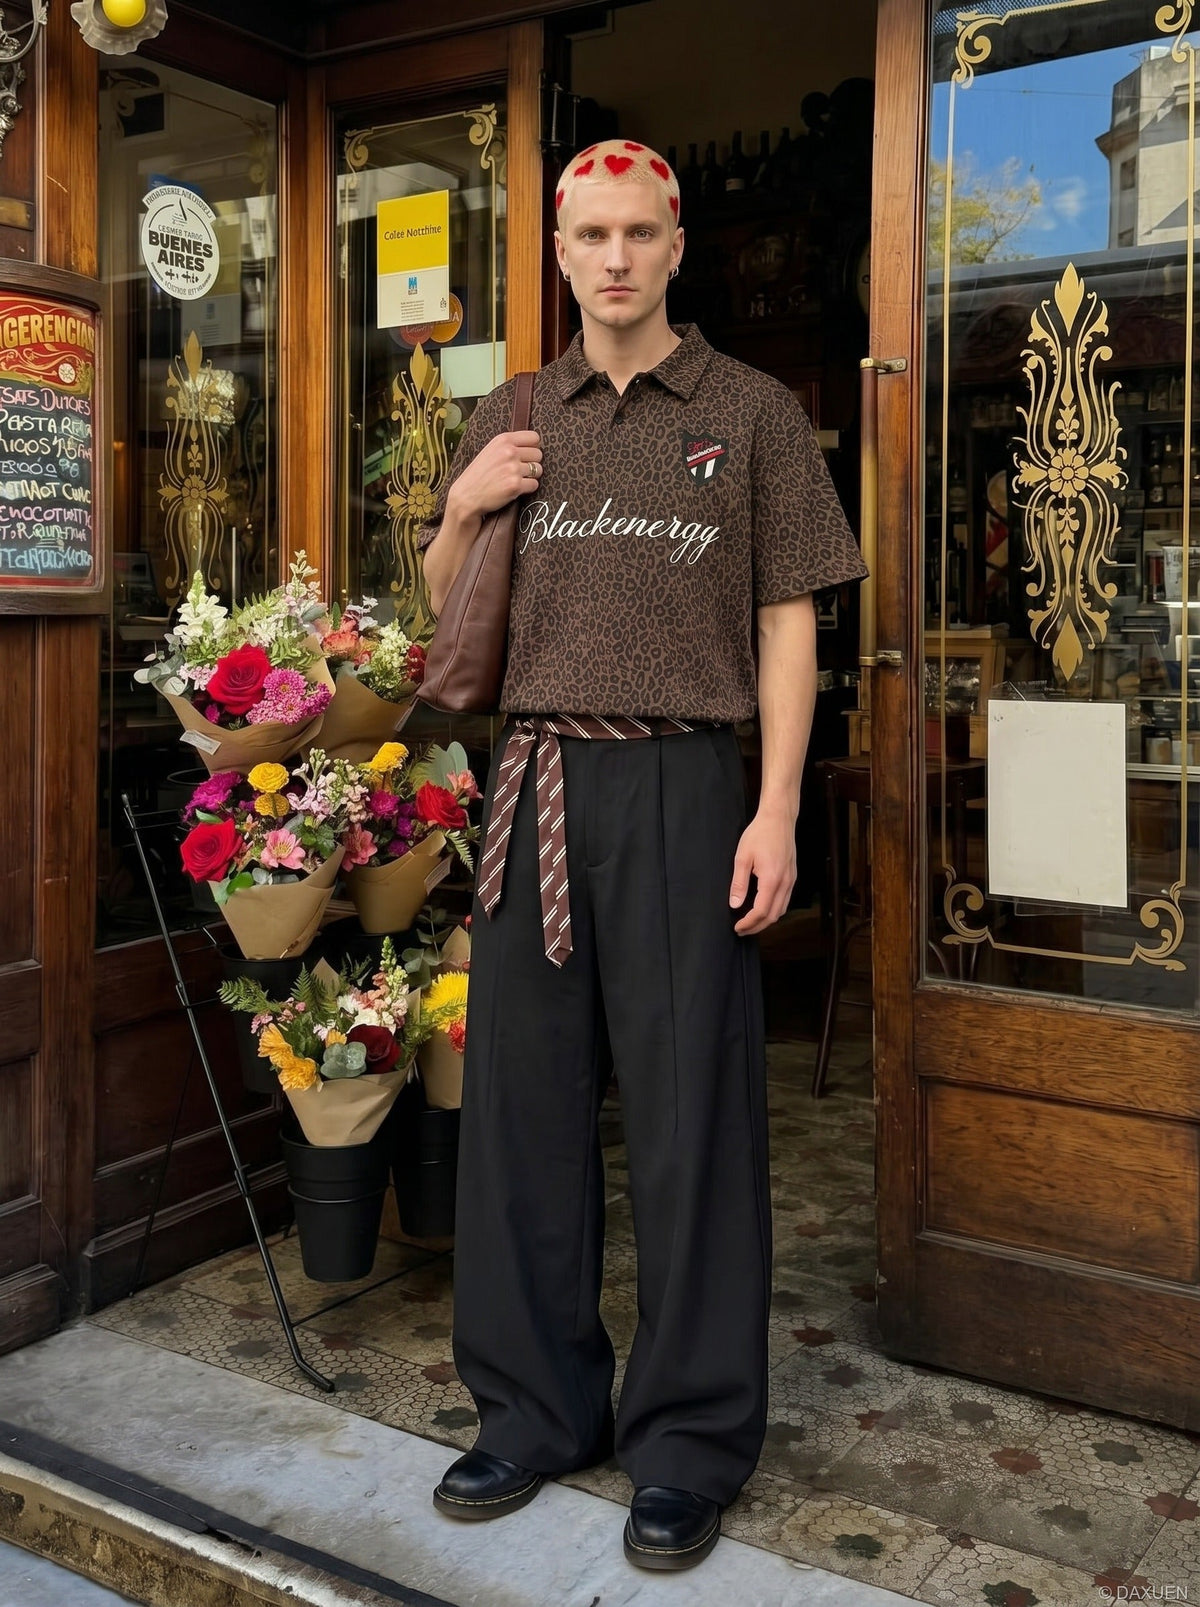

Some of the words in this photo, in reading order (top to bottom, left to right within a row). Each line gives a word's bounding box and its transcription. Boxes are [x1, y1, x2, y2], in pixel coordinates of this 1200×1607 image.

[148, 229, 213, 259] BUENES
[157, 249, 205, 273] AIRES
[519, 497, 720, 565] Blackenergy
